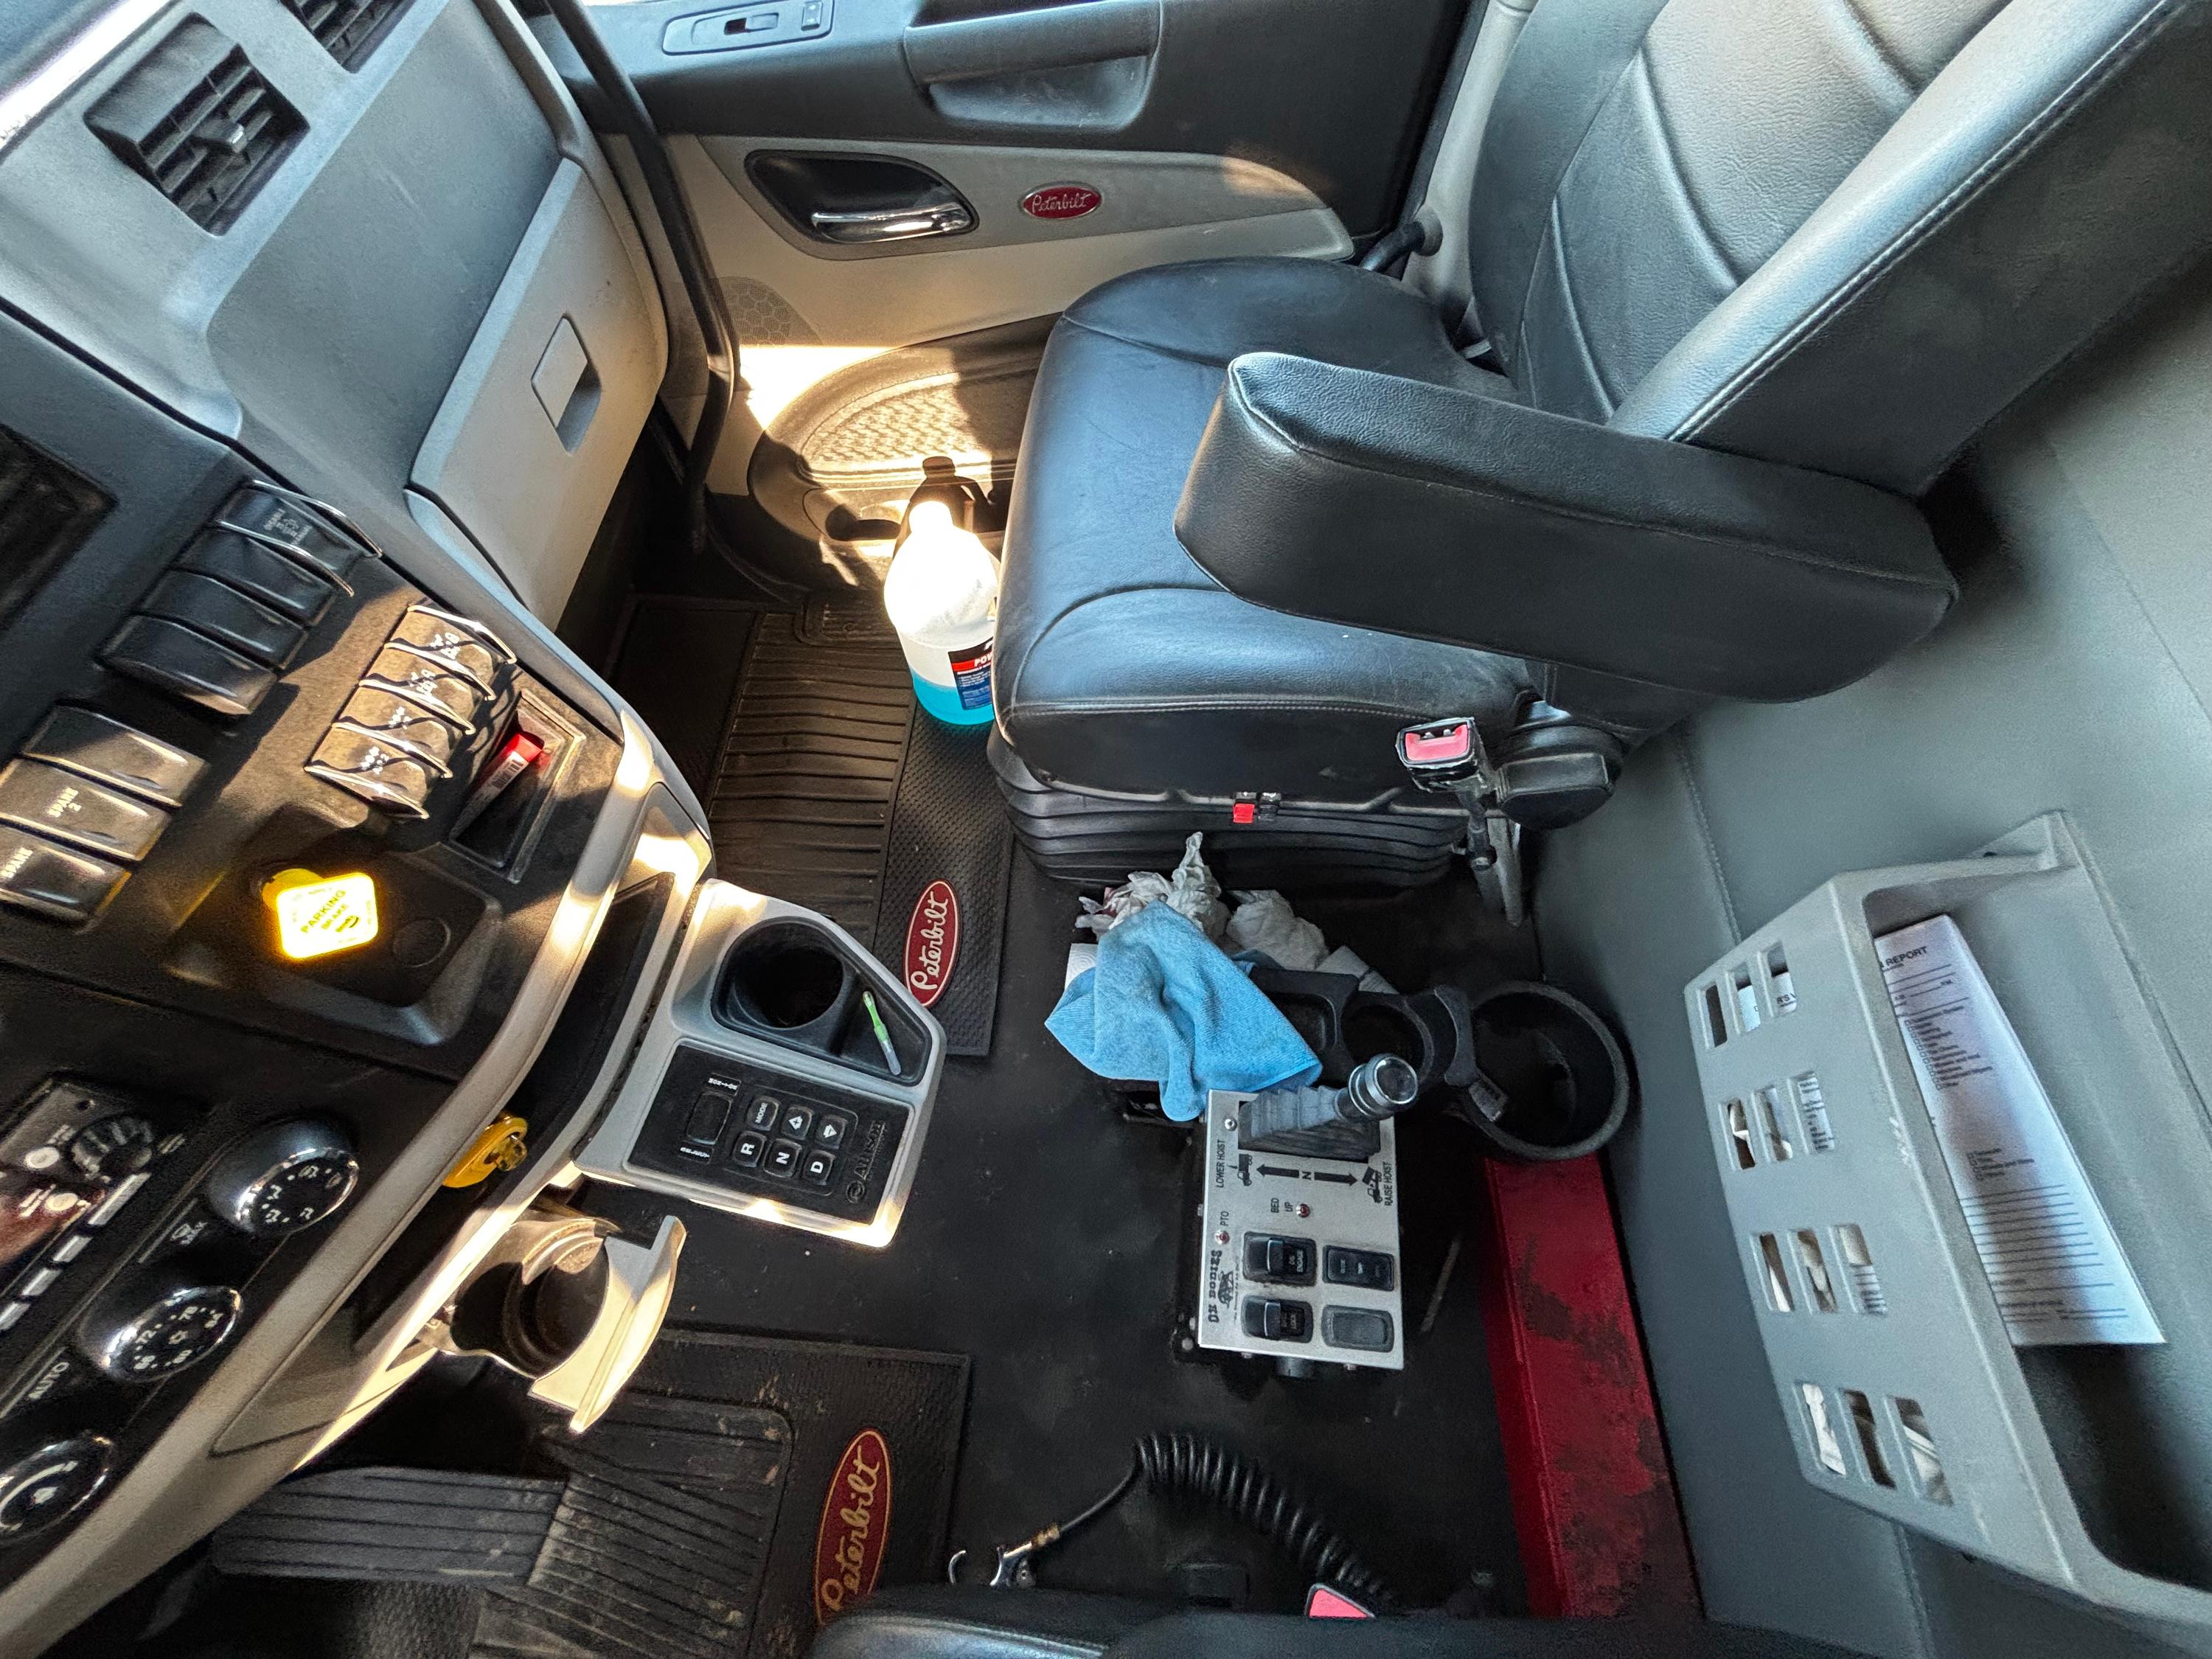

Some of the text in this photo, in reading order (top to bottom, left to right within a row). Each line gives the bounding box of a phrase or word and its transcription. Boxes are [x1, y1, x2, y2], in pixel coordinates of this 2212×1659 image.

[1032, 193, 1092, 213] Peterbilt
[300, 890, 347, 933] PARKING
[911, 891, 948, 990] Peterbilt
[1885, 946, 1927, 966] REPORT
[755, 1102, 768, 1124] MODE
[740, 1143, 755, 1155] R
[776, 1152, 790, 1165] N
[810, 1161, 824, 1174] D
[1217, 1139, 1226, 1188] LOWER HOIST
[1301, 1171, 1312, 1180] N
[1385, 1161, 1394, 1206] RAISE HOIST
[1270, 1198, 1280, 1214] BED
[1285, 1202, 1293, 1213] UP
[1220, 1211, 1229, 1227] PTO
[1209, 1250, 1222, 1298] BODIES
[29, 1362, 70, 1399] AUTO
[821, 1444, 880, 1611] Peterbilt
